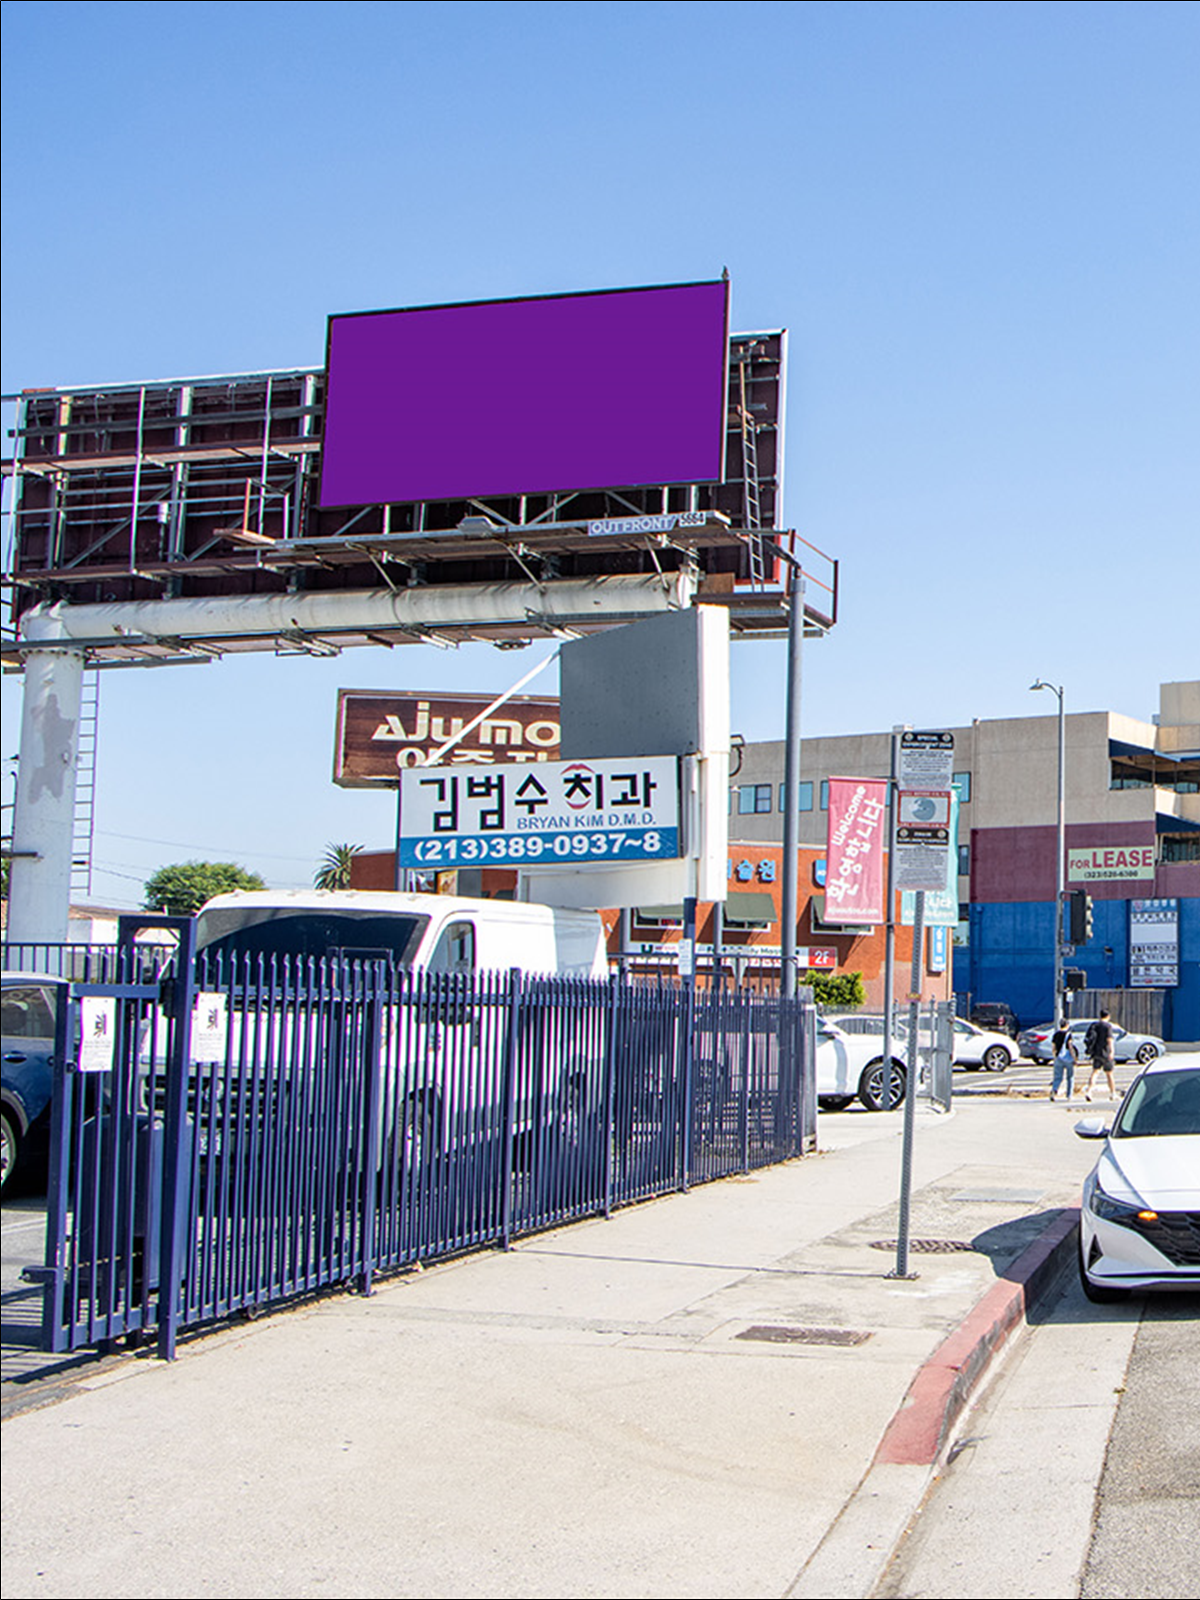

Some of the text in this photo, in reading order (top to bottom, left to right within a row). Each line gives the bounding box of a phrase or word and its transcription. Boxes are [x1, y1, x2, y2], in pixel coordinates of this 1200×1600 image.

[591, 516, 669, 534] OUTFRONT
[419, 772, 657, 832] 김범수 치과
[517, 815, 571, 830] BRYAN
[608, 812, 657, 827] D.M.D.
[831, 786, 866, 846] Welcome
[414, 831, 661, 861] (213)389-0937~8
[826, 798, 884, 902] 환영합니다
[1070, 849, 1153, 870] FOR LEASE
[814, 950, 829, 965] 2F
